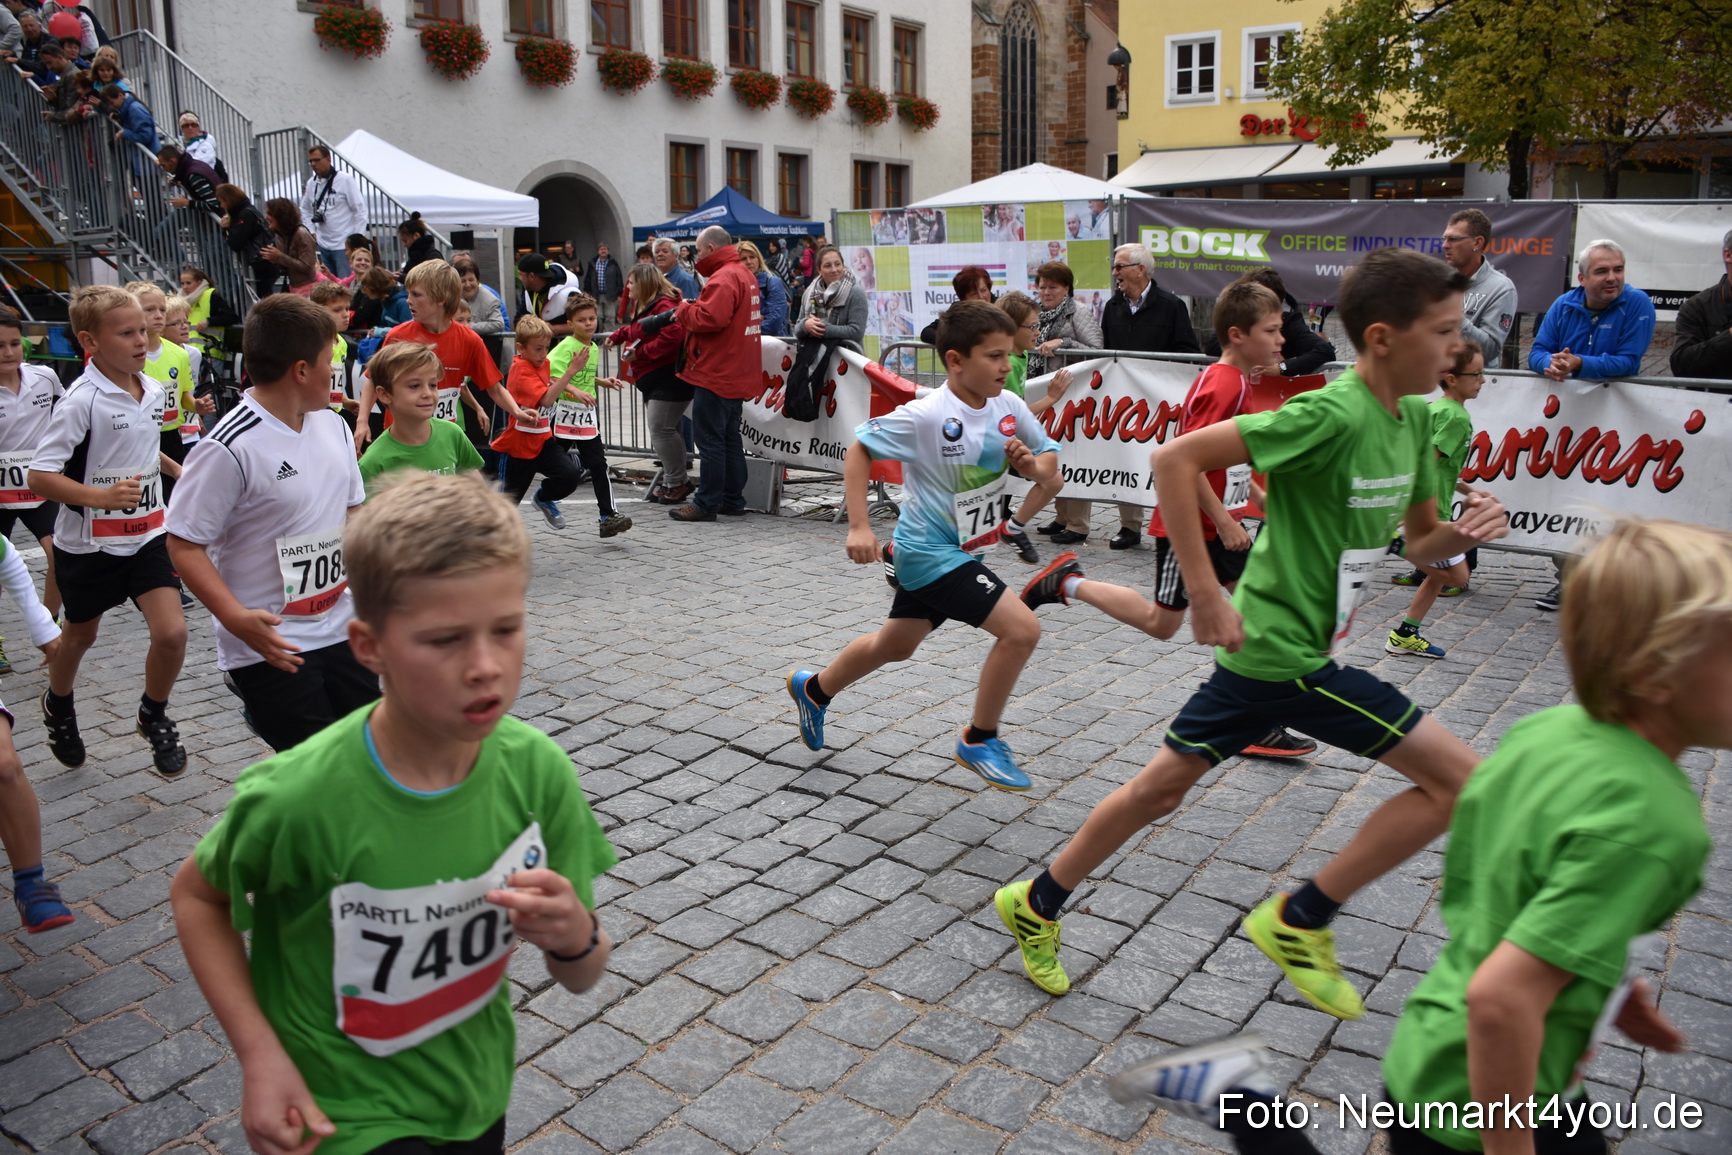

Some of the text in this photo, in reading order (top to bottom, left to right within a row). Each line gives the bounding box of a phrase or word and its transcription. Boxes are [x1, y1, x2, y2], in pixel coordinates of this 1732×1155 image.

[1240, 114, 1285, 136] Der
[1141, 229, 1265, 258] BOCK
[1280, 235, 1346, 252] OFFICE
[1353, 236, 1443, 254] INDUSTR
[1178, 260, 1190, 271] by
[1193, 263, 1222, 272] smart
[925, 290, 960, 305] Neue
[561, 410, 593, 426] 7114
[112, 423, 129, 431] Luca
[276, 470, 299, 481] adidas
[124, 522, 148, 534] Luca
[281, 544, 316, 558] PARTL
[339, 901, 419, 925] PARTL
